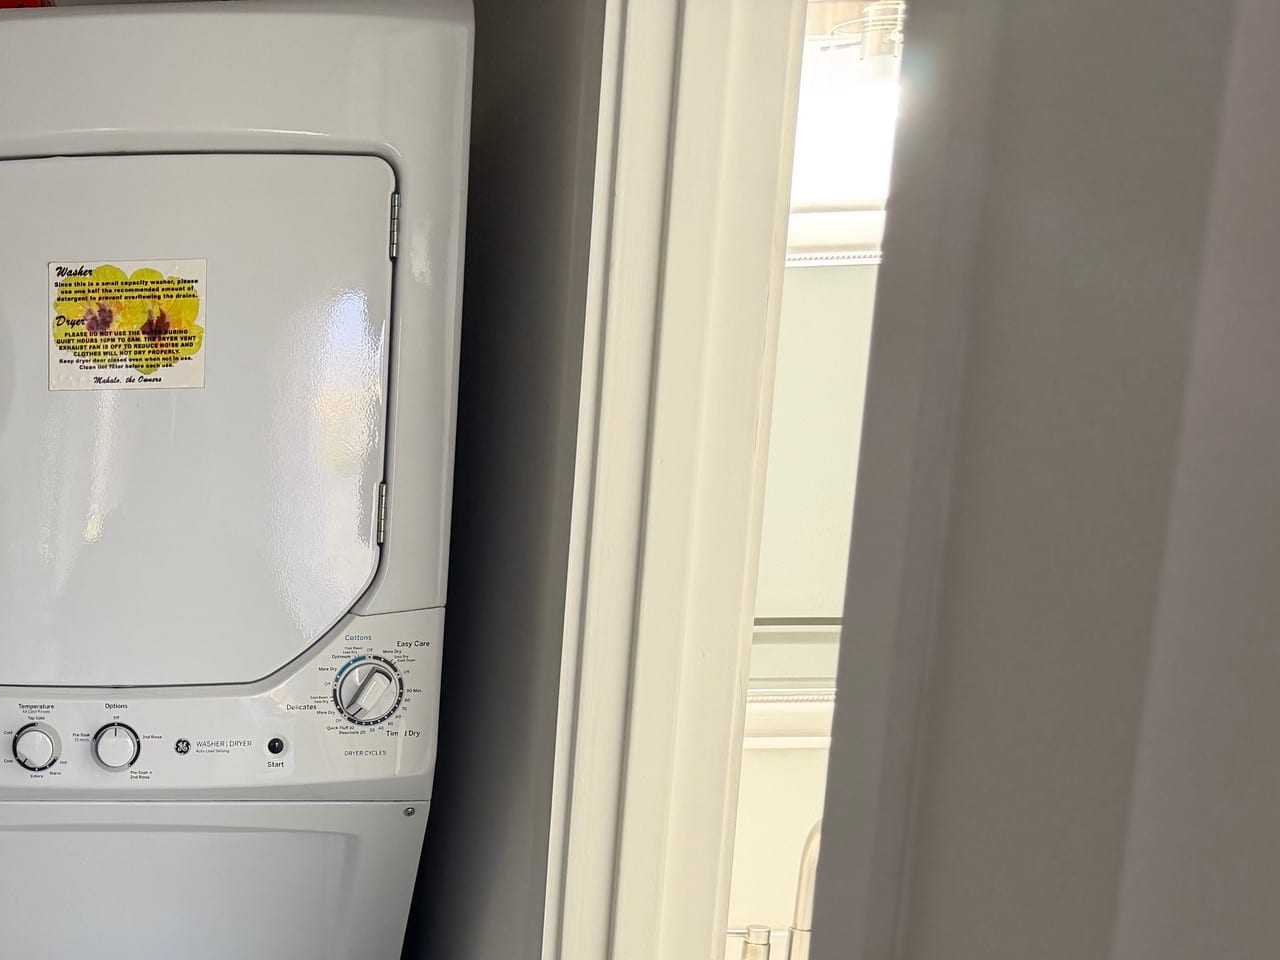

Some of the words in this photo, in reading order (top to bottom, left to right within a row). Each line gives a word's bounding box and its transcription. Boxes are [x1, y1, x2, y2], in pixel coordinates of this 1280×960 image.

[55, 265, 93, 277] Washer
[55, 315, 85, 328] Dryer
[396, 640, 413, 648] Easy
[105, 702, 128, 710] Options
[408, 730, 421, 738] Dry
